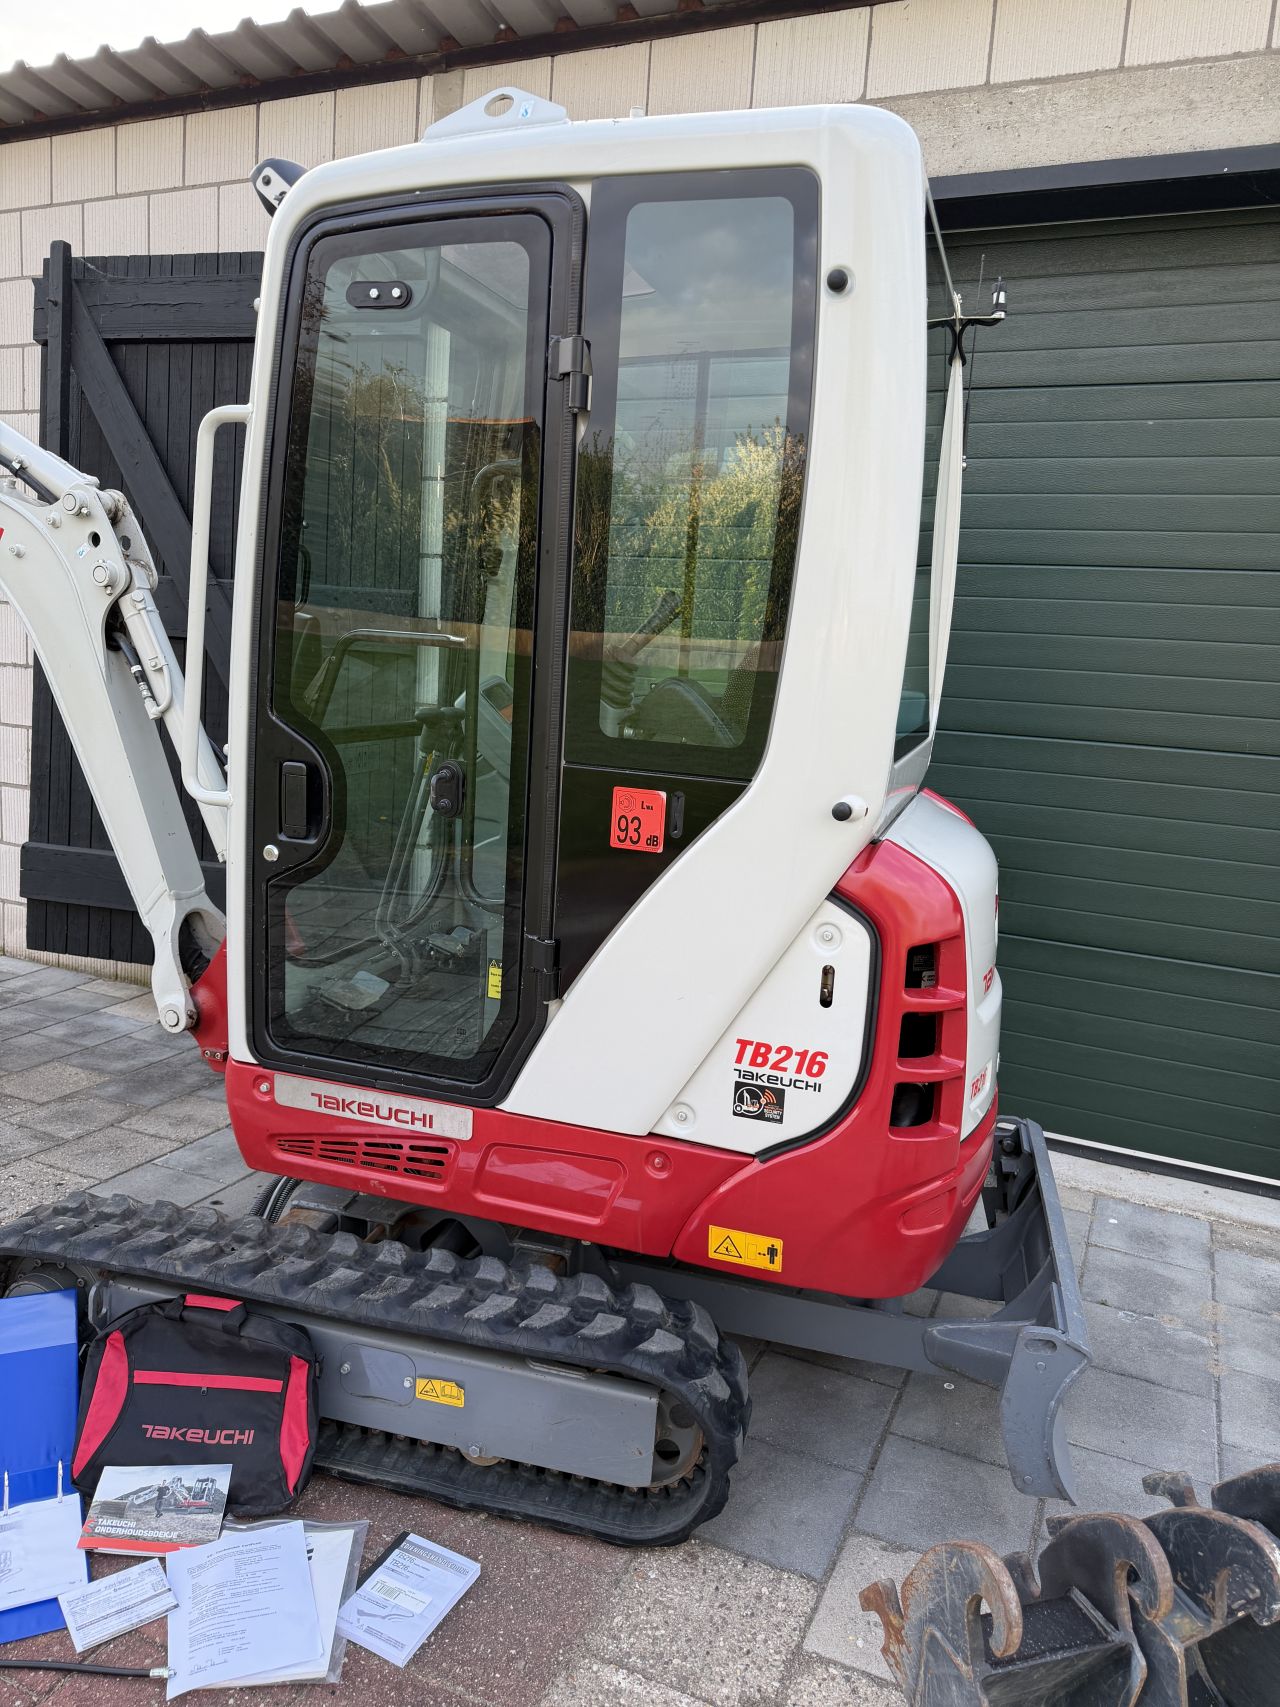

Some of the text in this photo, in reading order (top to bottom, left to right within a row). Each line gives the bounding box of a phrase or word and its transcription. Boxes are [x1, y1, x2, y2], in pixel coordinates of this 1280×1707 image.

[617, 815, 659, 847] 93 dB
[735, 1038, 829, 1078] TB216
[733, 1068, 822, 1093] TAKEUCHI
[311, 1092, 434, 1129] TAKEUCHI
[142, 1424, 255, 1445] TAKEUCHI
[94, 1526, 179, 1539] ONDERHOUDSBOEKJE
[97, 1518, 136, 1528] TAKEUCHI
[389, 1559, 410, 1572] TB216
